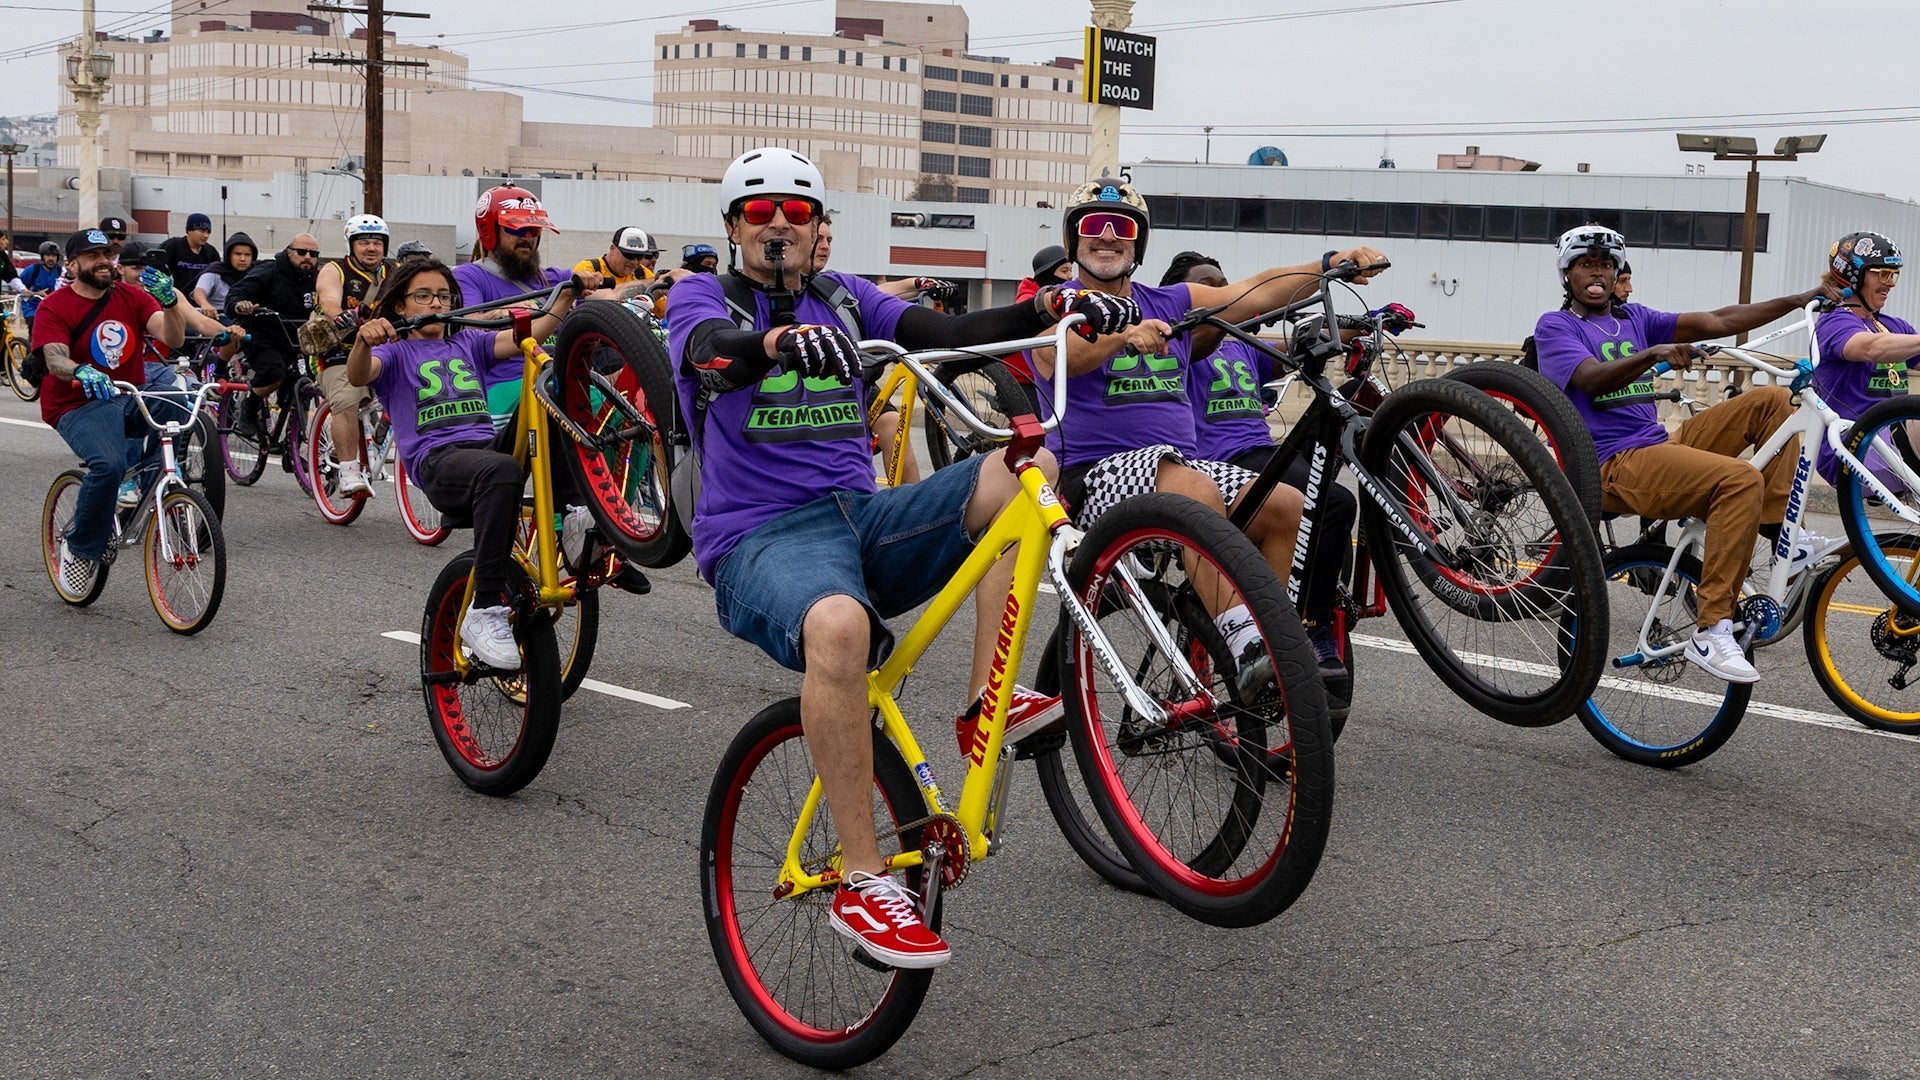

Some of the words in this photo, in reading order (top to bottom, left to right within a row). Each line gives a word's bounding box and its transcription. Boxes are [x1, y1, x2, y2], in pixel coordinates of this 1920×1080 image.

[1104, 36, 1153, 58] WATCH
[1103, 60, 1132, 78] THE
[1101, 83, 1141, 101] ROAD
[1119, 166, 1132, 184] 5
[101, 322, 125, 347] S
[418, 359, 481, 401] SE
[1113, 378, 1156, 393] TEAM
[420, 403, 458, 422] TEAM
[757, 408, 811, 426] TEAM
[810, 404, 860, 425] RIDER
[1211, 399, 1246, 412] TEAM
[1291, 514, 1312, 570] THAN
[1305, 441, 1327, 511] YOURS
[970, 726, 989, 767] LIL
